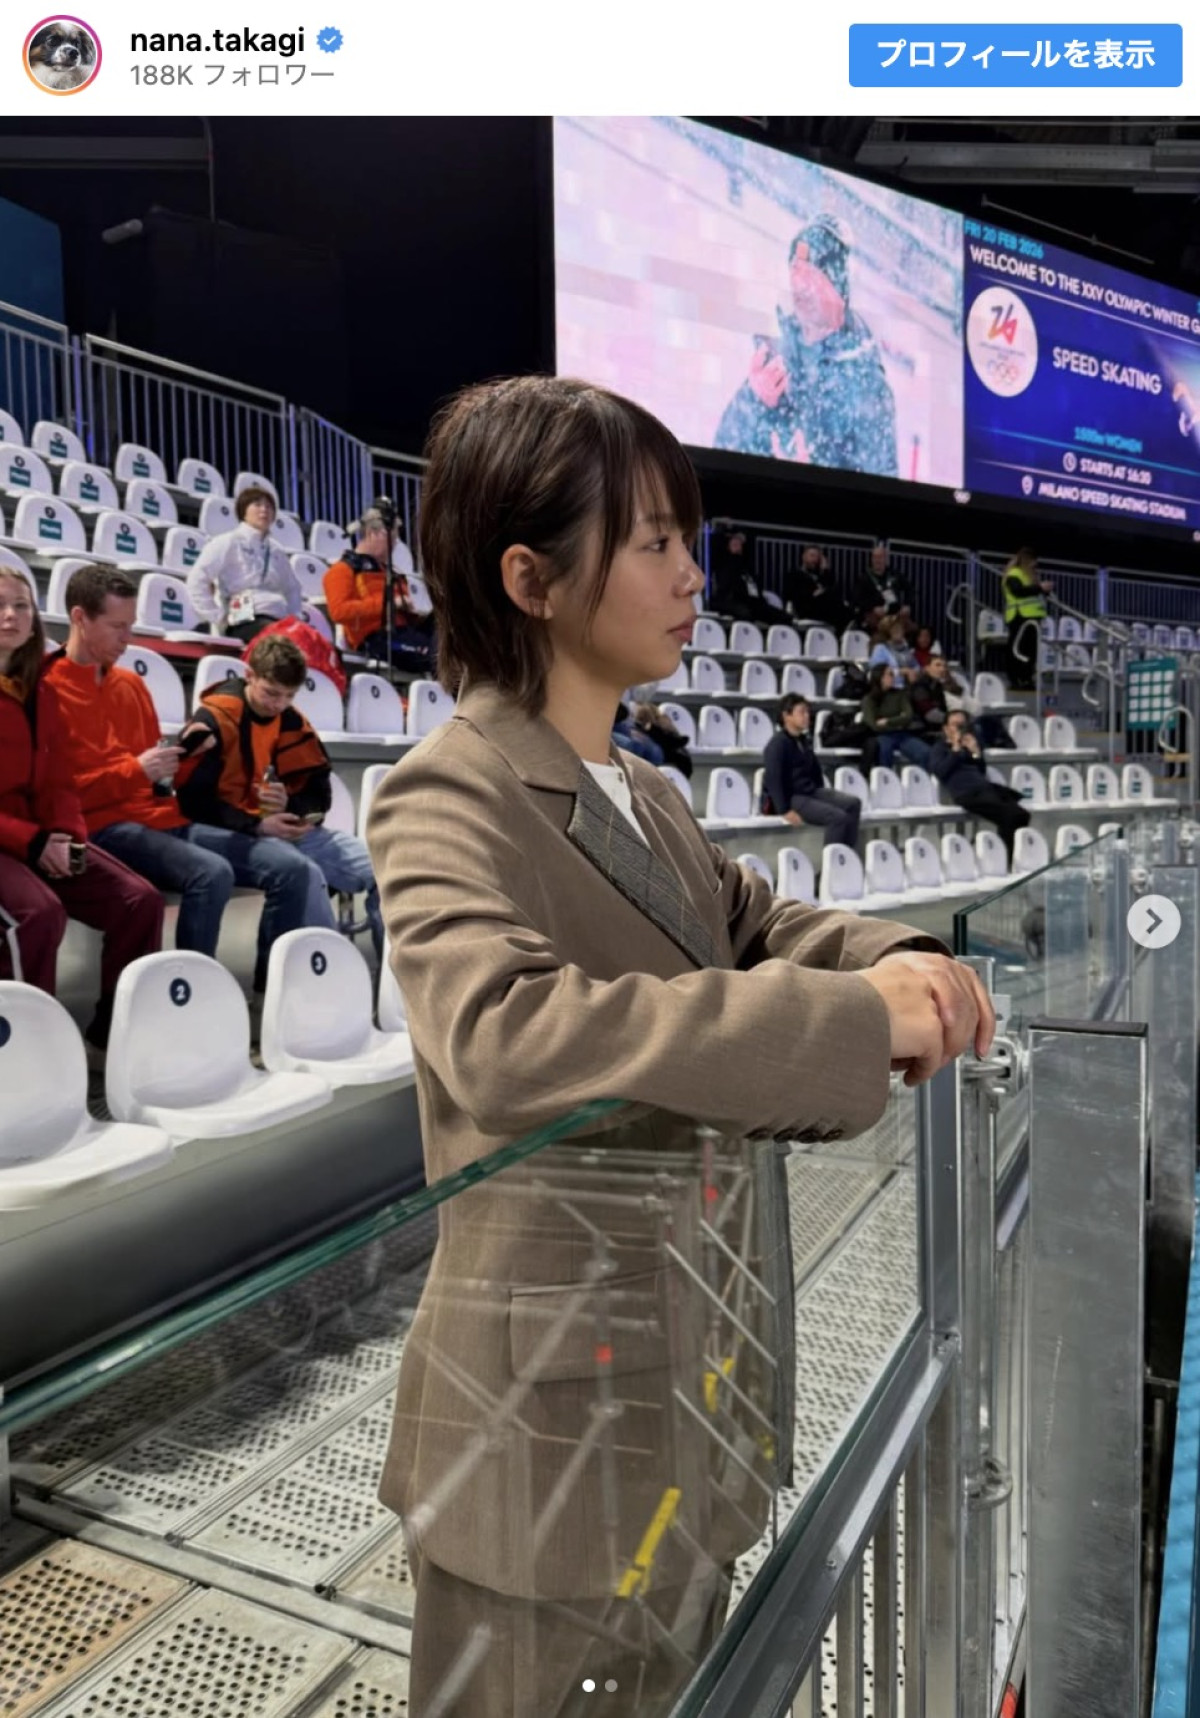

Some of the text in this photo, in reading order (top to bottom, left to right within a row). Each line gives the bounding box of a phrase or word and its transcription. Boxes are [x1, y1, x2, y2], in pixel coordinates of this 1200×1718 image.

[964, 219, 1044, 260] FRI 20 FEB 2026
[969, 244, 1037, 280] WELCOME
[1038, 266, 1056, 287] TO
[1057, 273, 1080, 296] THE
[1081, 280, 1105, 301] XXV
[1105, 289, 1152, 318] OLYMPIC
[1152, 305, 1190, 331] WINTER
[1053, 345, 1099, 379] SPEED
[1101, 360, 1162, 396] SKATING
[1080, 458, 1113, 478] STARTS
[1113, 465, 1126, 480] AT
[1038, 482, 1186, 521] MILANO SPEED SKATING STADIUM
